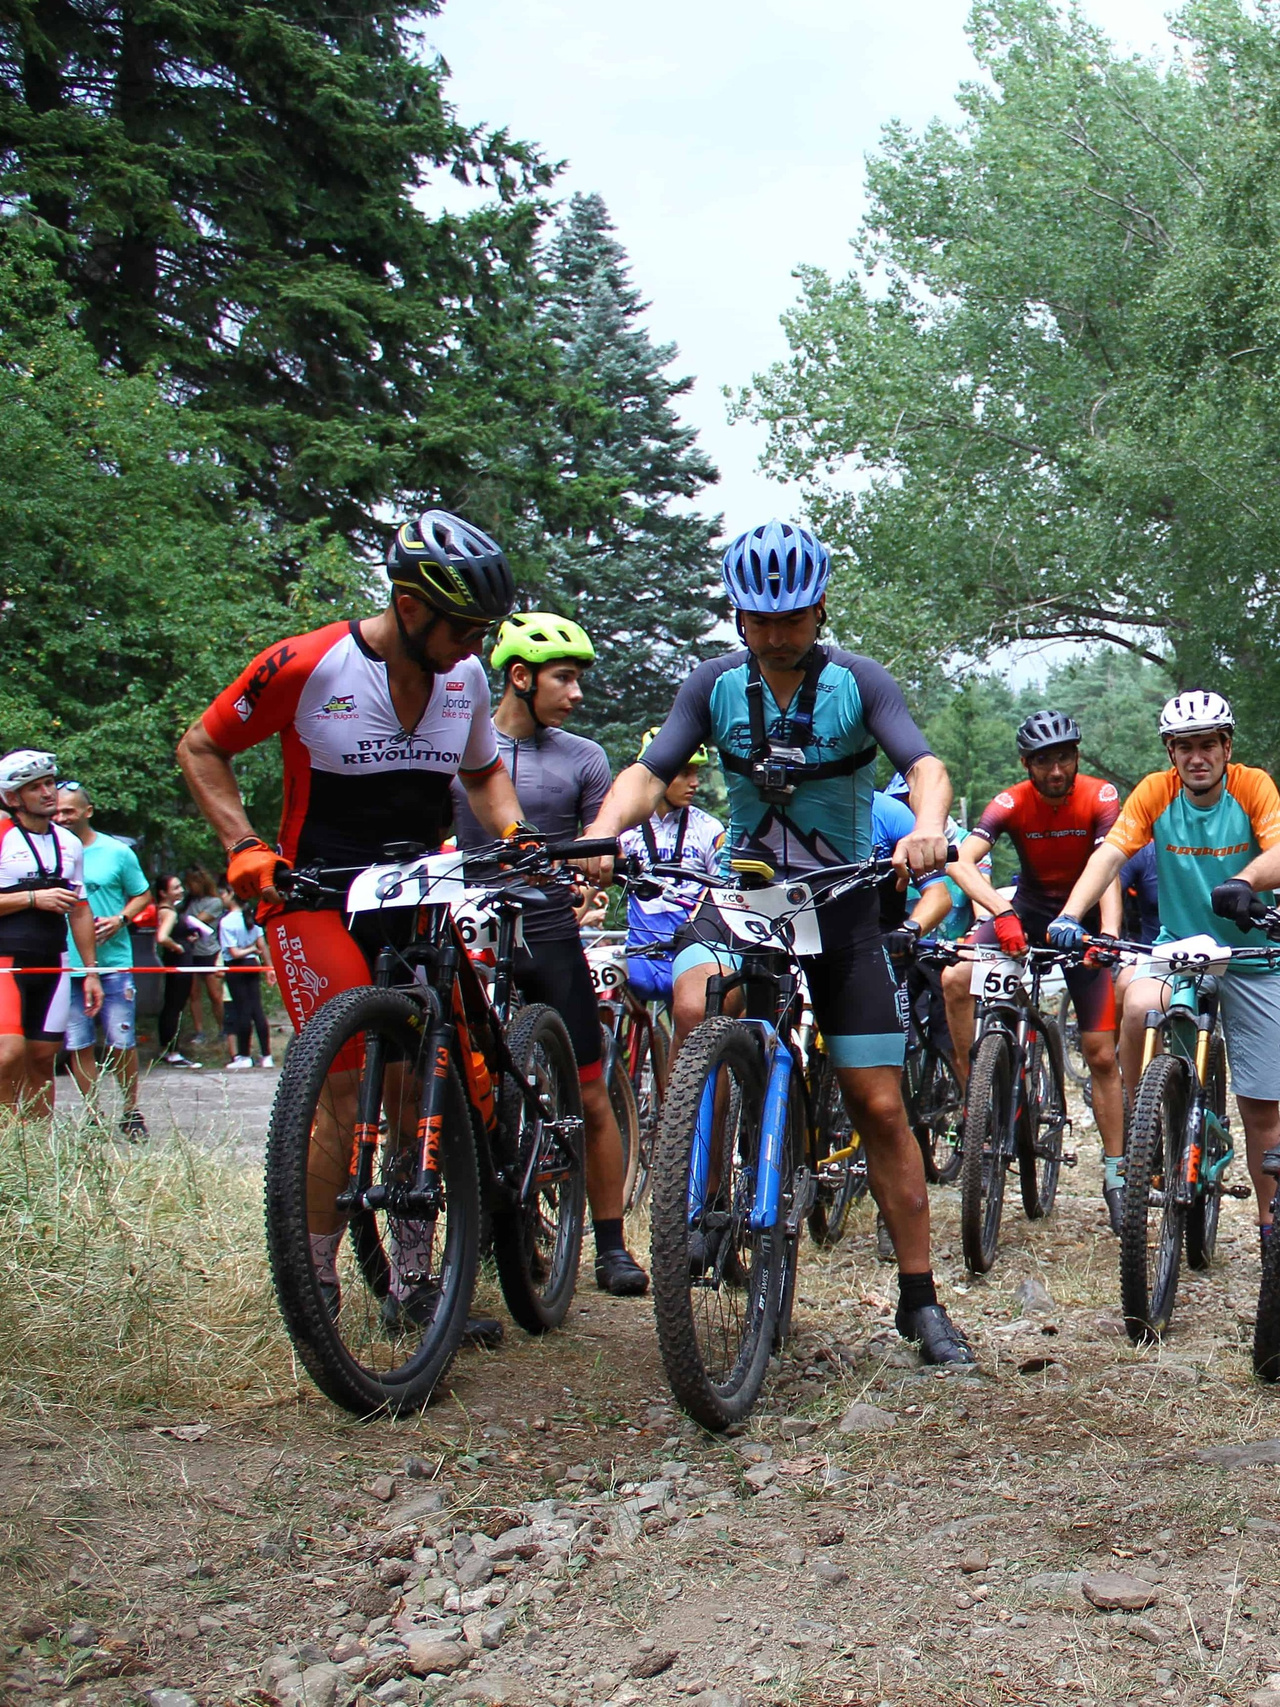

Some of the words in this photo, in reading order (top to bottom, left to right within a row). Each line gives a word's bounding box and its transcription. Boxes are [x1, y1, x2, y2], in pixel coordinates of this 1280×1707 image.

[445, 565, 474, 603] SCOTT
[442, 708, 456, 718] bike
[342, 750, 461, 764] REVOLUTION
[358, 739, 386, 751] BT
[375, 864, 430, 900] 81
[457, 916, 498, 943] 61
[745, 917, 796, 949] 90
[289, 937, 307, 963] BT
[984, 972, 1020, 995] 56
[761, 1268, 769, 1296] SWISS
[758, 1294, 766, 1311] DT
